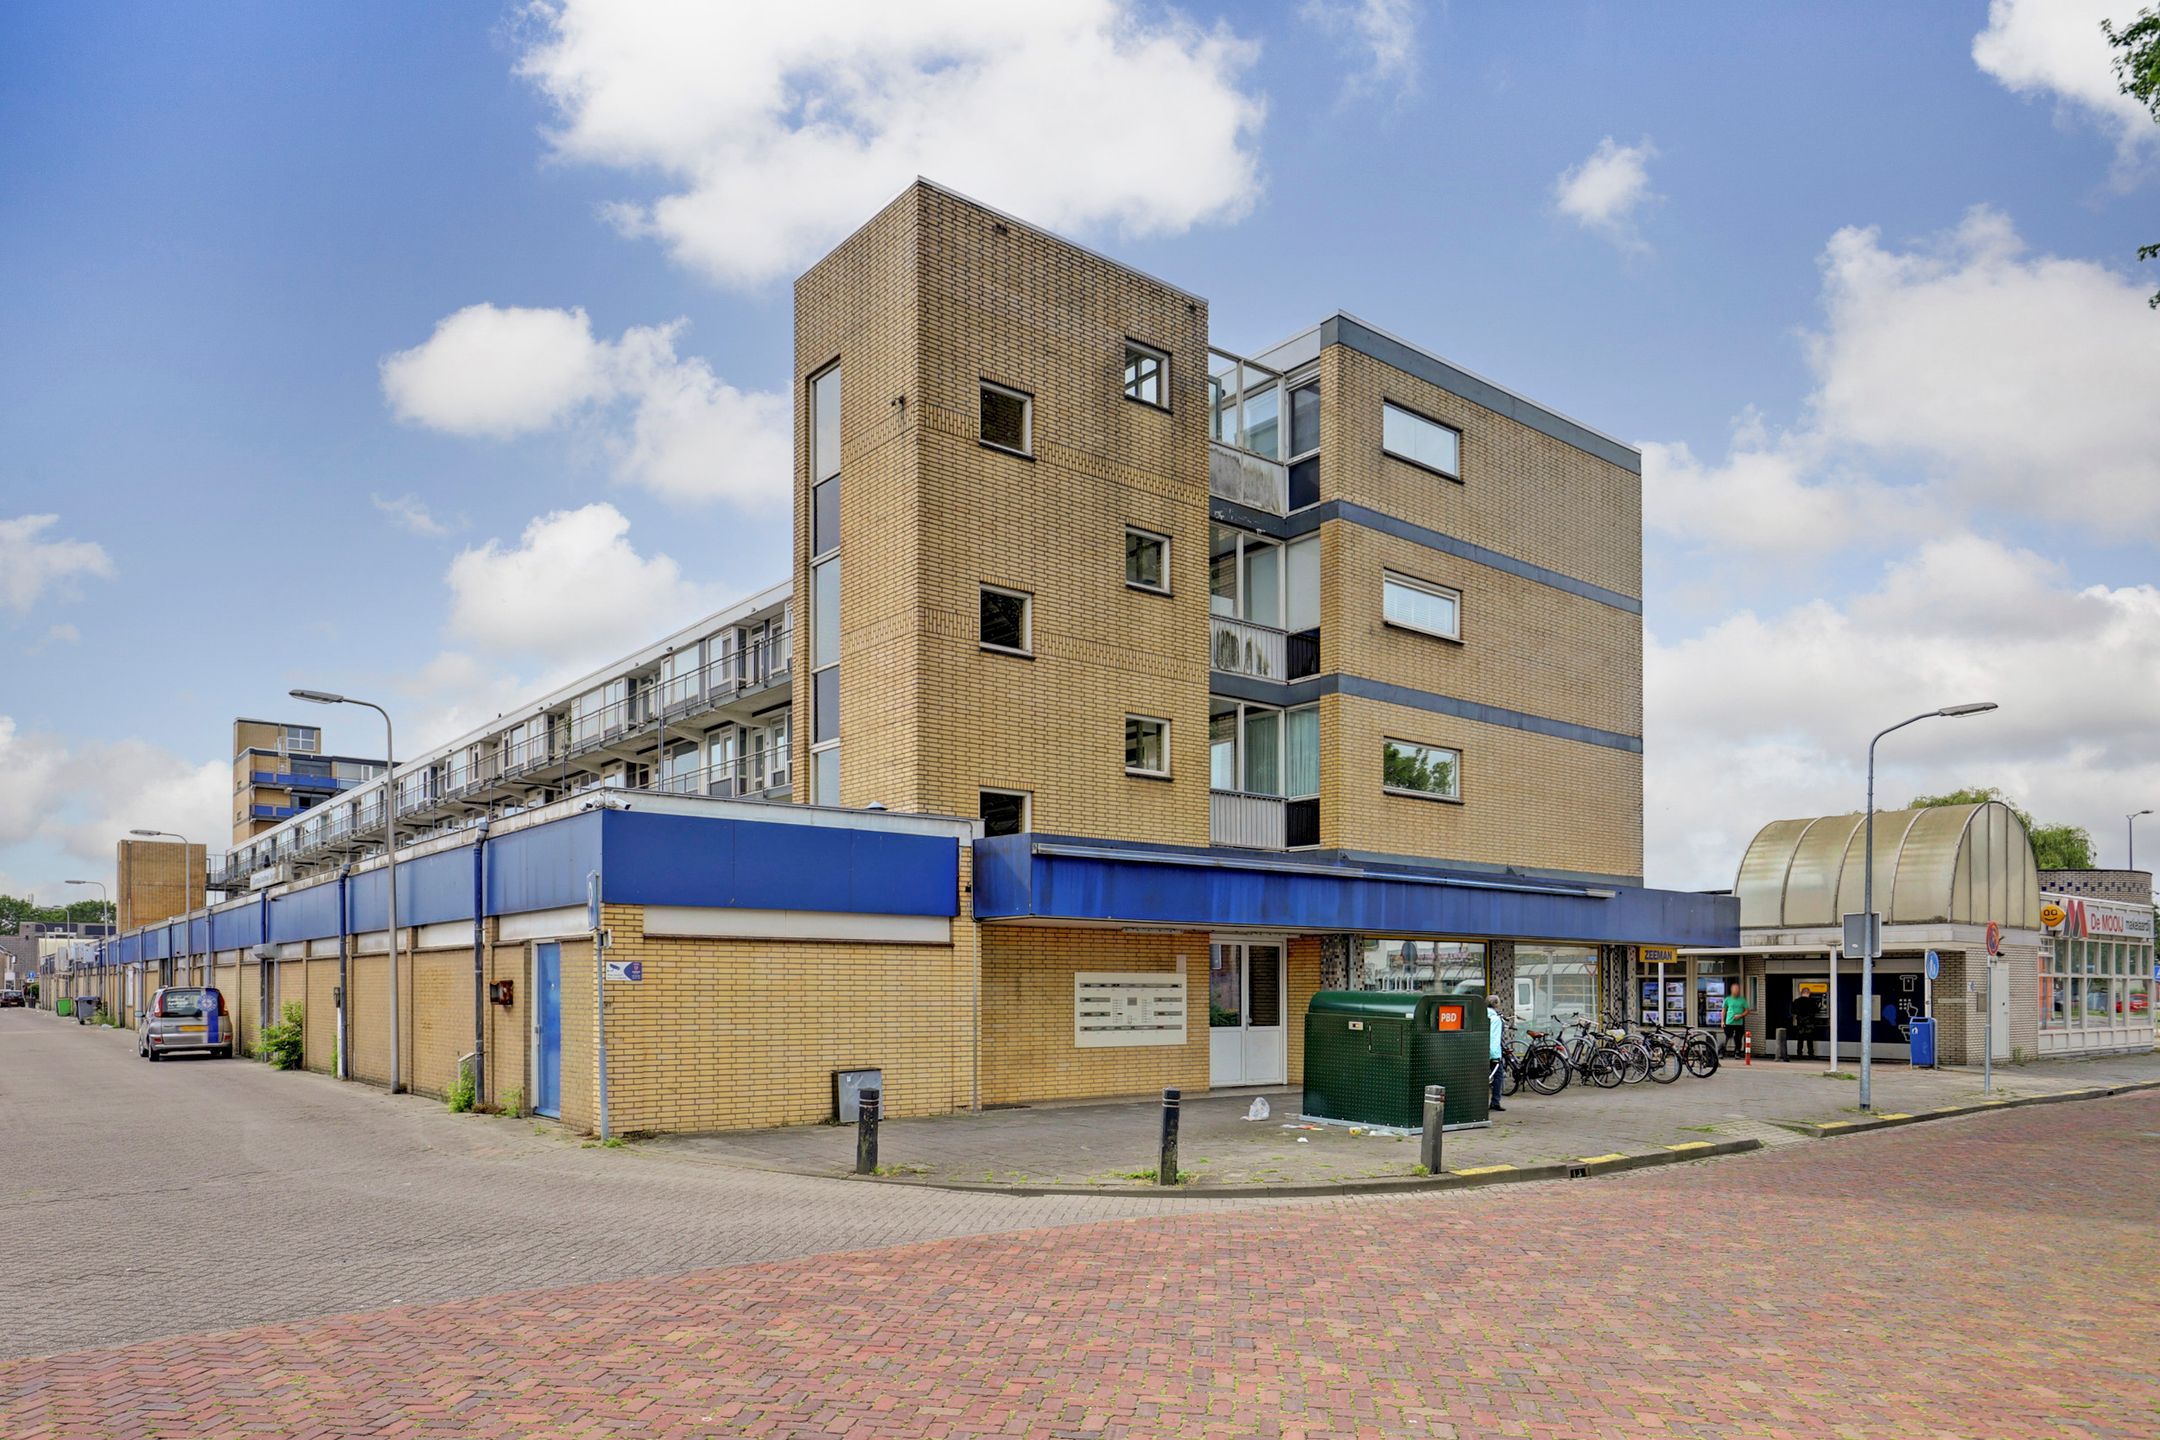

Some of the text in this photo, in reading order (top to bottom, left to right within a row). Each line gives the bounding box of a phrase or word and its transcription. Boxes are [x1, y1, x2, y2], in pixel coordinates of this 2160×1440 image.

[2091, 913, 2100, 930] De
[1644, 950, 1673, 961] ZEEMAN
[1440, 1012, 1457, 1022] PBD
